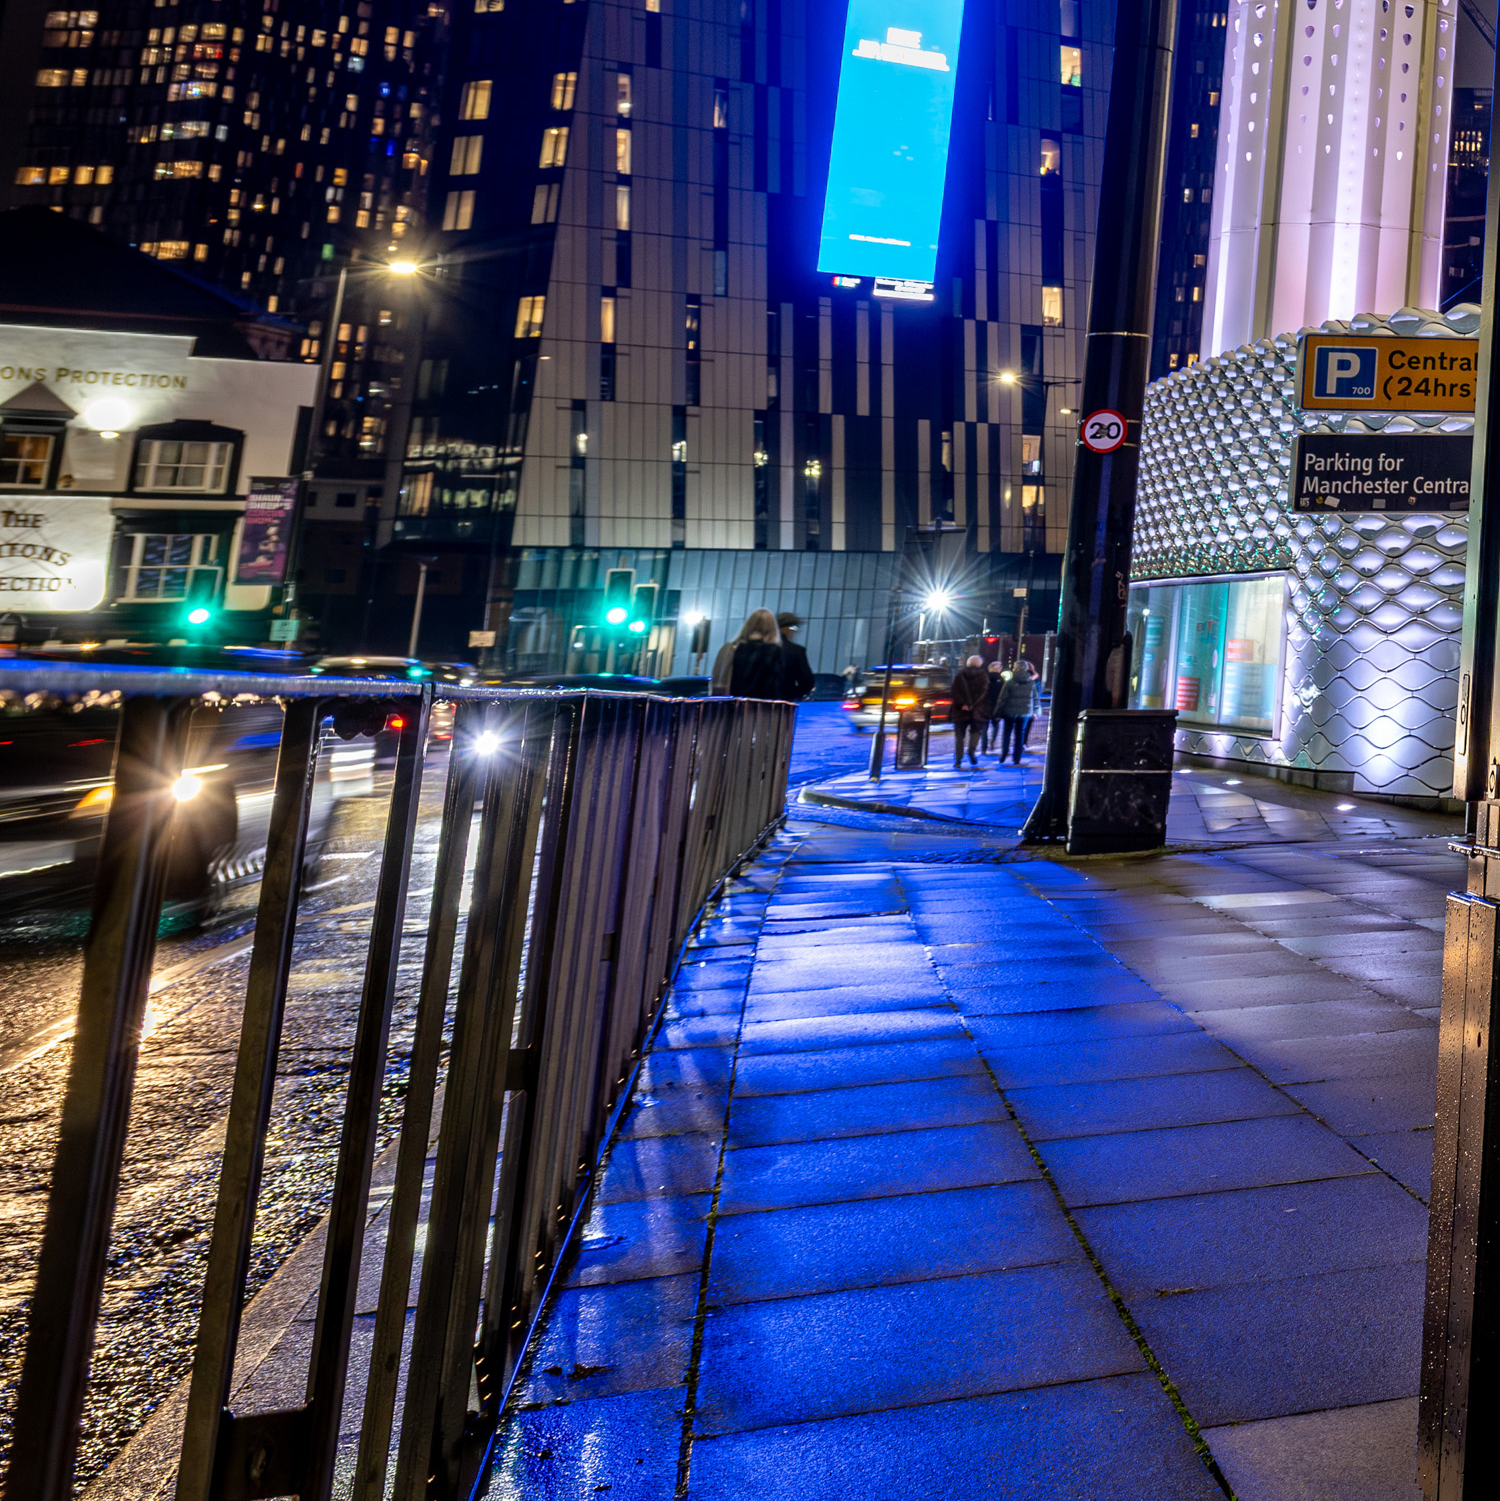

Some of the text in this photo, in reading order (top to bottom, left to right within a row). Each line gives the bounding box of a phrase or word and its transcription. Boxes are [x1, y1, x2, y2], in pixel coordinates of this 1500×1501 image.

[1388, 350, 1478, 371] Central
[0, 366, 187, 389] ONS PROTECTION
[1326, 352, 1361, 394] P
[1352, 386, 1371, 395] 700
[1089, 422, 1121, 439] 20
[1304, 452, 1404, 476] Parking for
[1302, 476, 1469, 494] Manchester Centra
[0, 543, 72, 566] IONS
[0, 577, 75, 592] ECTIO
